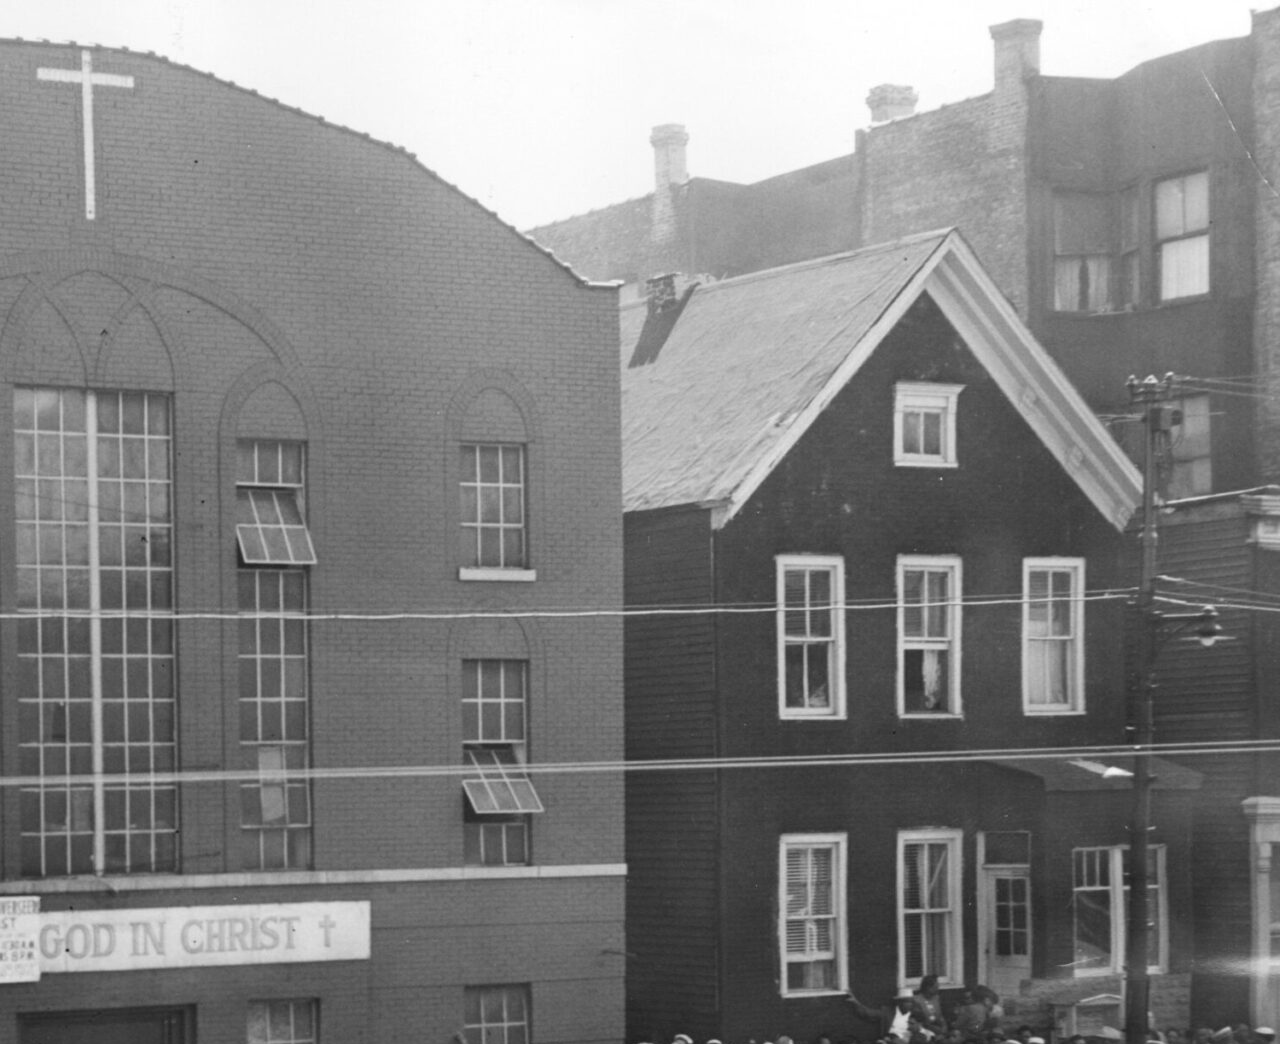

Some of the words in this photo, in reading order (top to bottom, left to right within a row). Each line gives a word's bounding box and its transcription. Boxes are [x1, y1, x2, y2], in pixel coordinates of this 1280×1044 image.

[39, 922, 117, 959] GOD
[129, 921, 167, 957] IN
[180, 916, 301, 955] CHRIST
